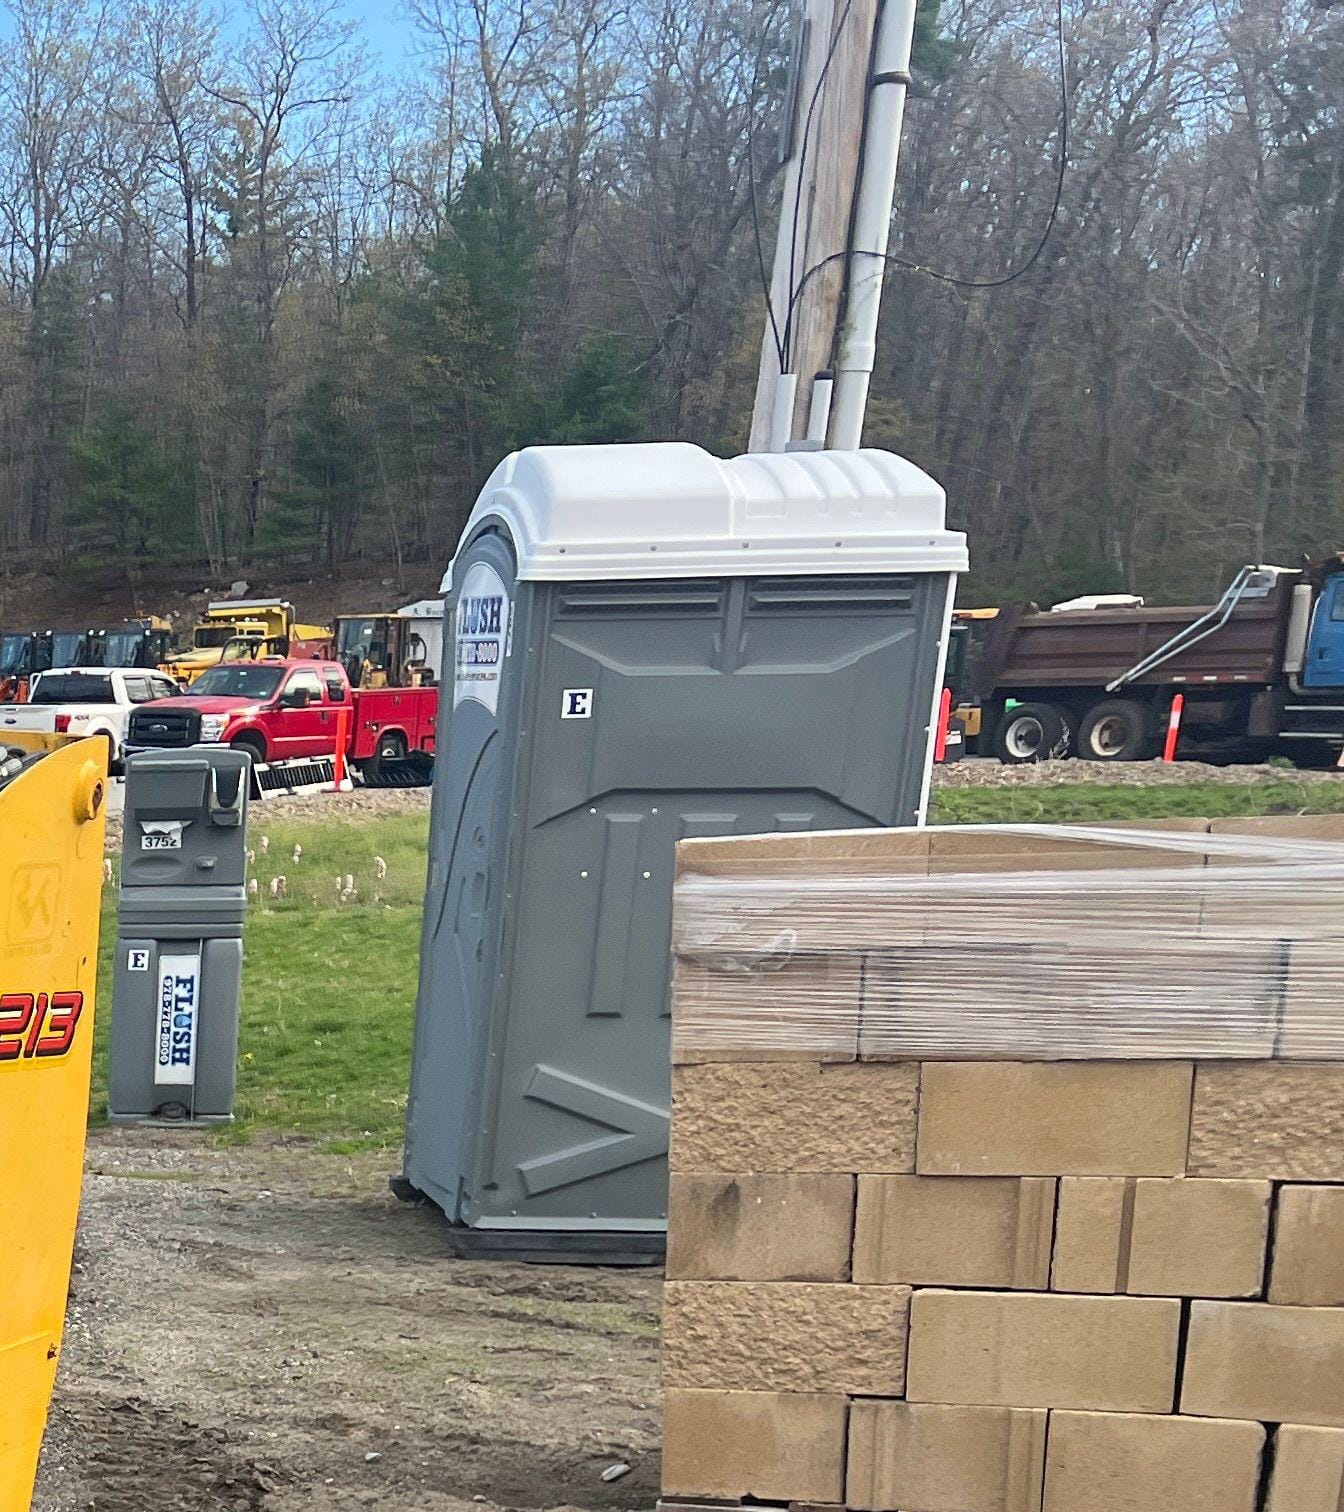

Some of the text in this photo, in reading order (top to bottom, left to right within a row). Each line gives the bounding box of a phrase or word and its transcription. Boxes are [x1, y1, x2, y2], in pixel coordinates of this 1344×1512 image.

[459, 595, 503, 634] LUSH
[567, 692, 587, 715] E
[132, 952, 146, 968] E
[172, 975, 195, 1066] FLUSH
